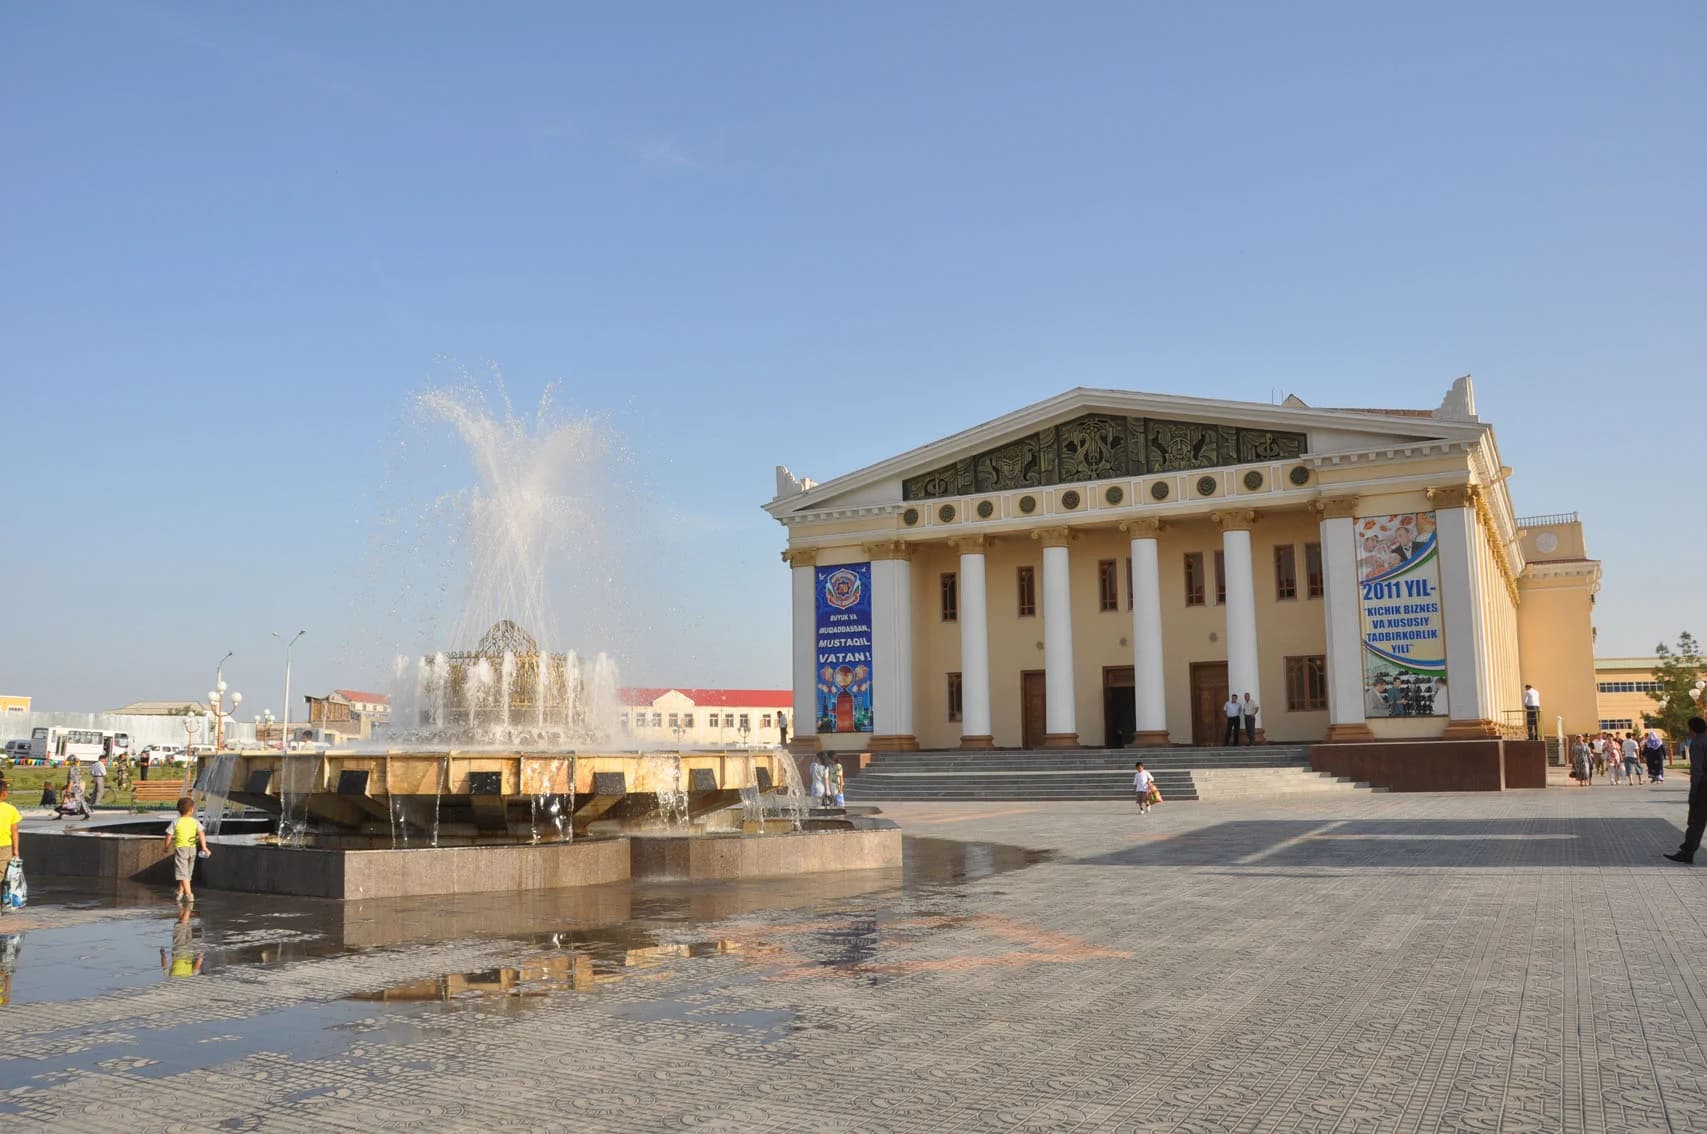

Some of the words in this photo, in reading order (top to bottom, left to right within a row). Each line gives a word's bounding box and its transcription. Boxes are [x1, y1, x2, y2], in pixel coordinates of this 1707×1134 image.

[1363, 581, 1401, 600] 2011
[1403, 603, 1438, 615] BIZNES
[1372, 619, 1385, 629] VA
[1387, 617, 1430, 628] XUSUSIY
[1366, 629, 1438, 642] TADBIRKORLIK
[818, 637, 871, 648] MUSTAQIL
[819, 651, 872, 664] VATAN!
